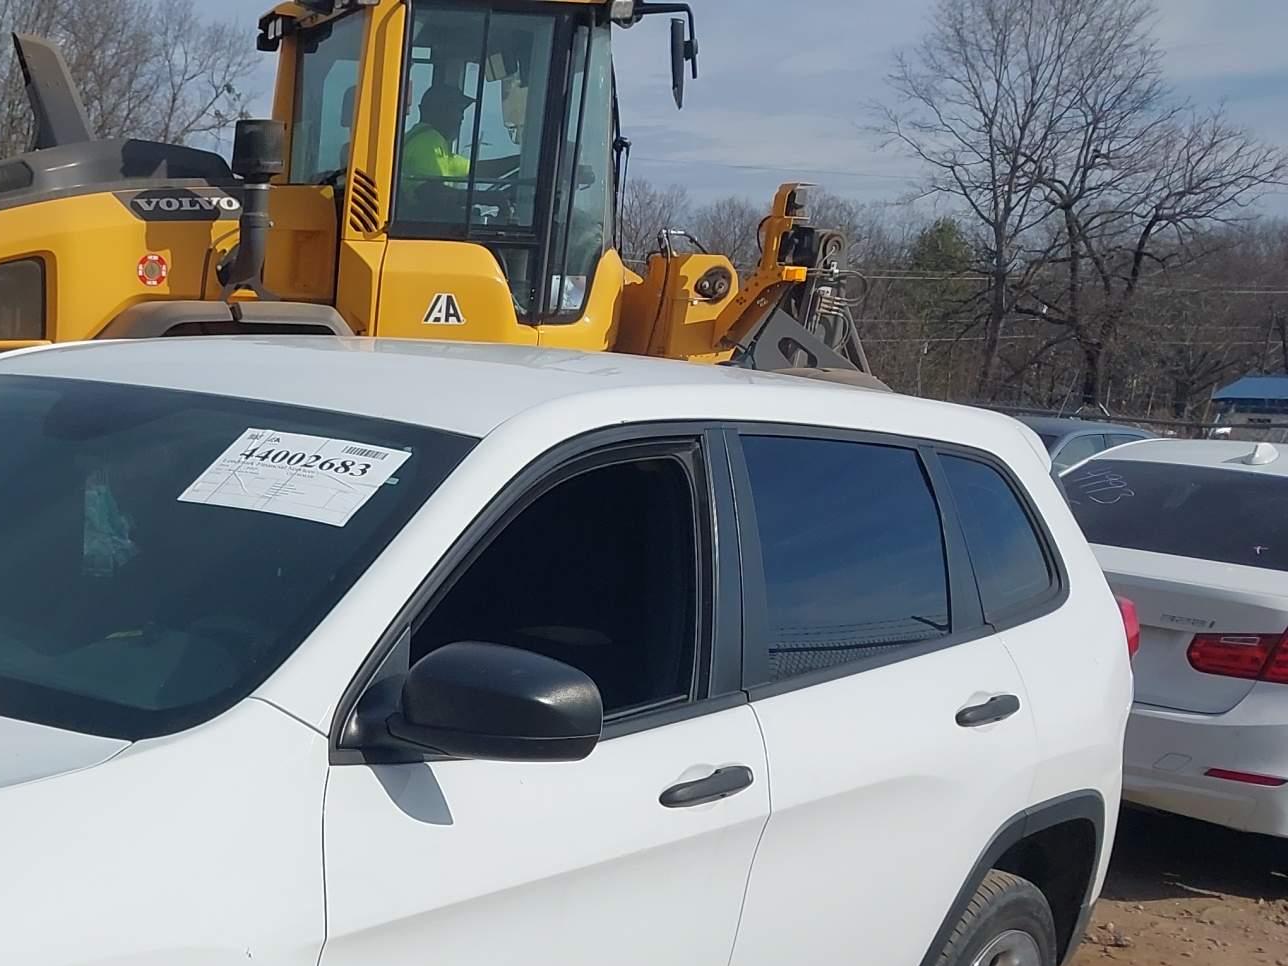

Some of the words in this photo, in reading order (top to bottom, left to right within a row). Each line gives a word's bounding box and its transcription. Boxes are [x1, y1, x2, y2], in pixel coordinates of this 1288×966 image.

[133, 196, 241, 211] VOLVO
[423, 293, 462, 323] AA
[239, 446, 372, 477] 44002683
